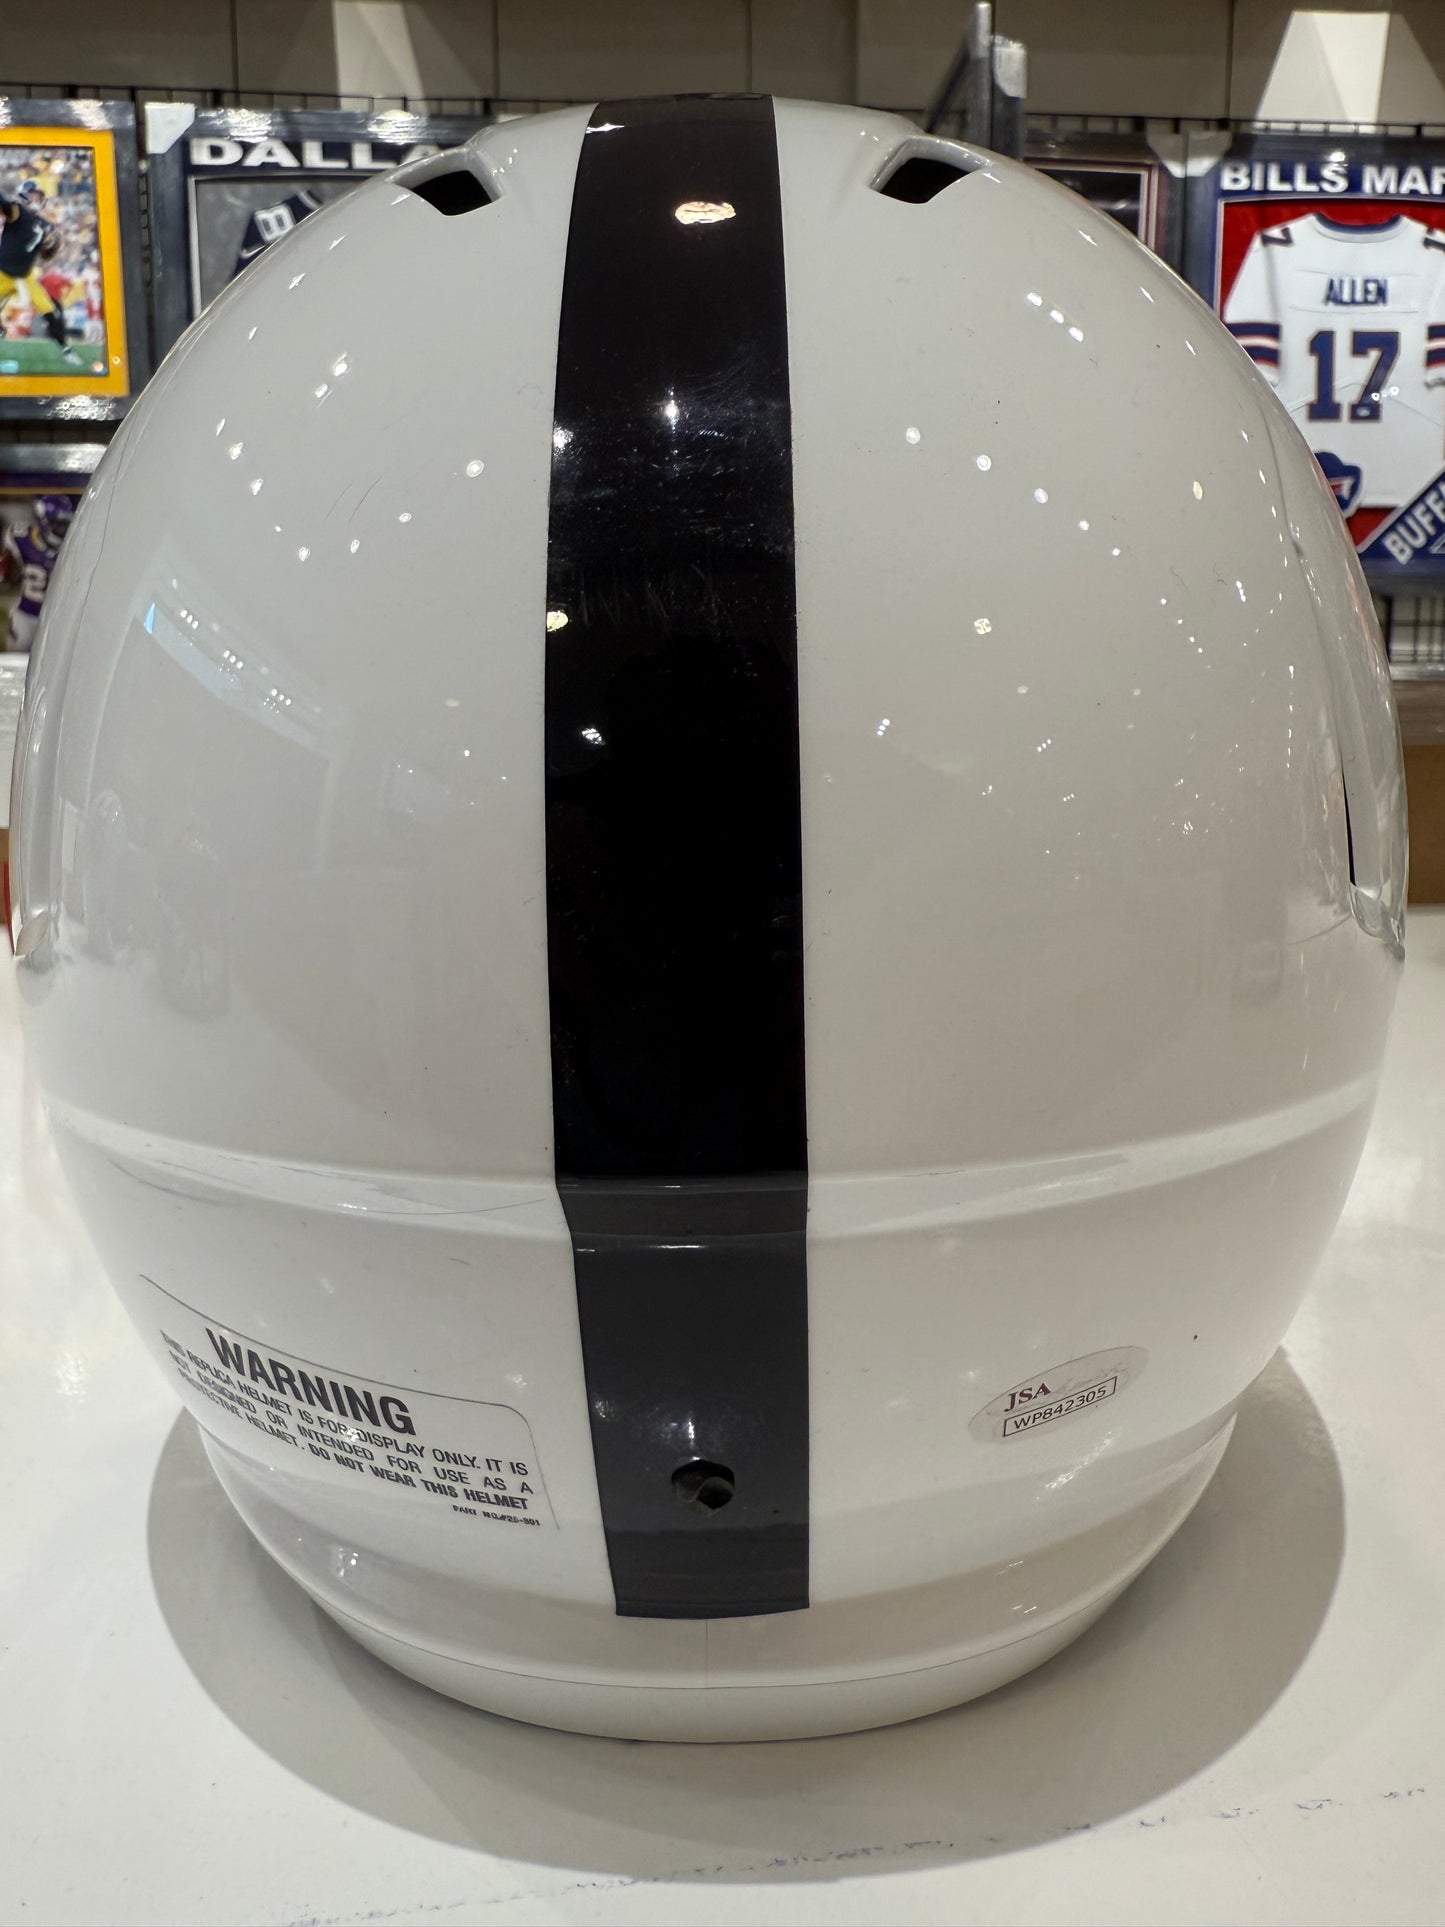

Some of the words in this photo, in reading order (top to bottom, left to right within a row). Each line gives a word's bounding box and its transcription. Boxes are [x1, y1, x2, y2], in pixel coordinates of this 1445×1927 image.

[1220, 162, 1349, 193] BILLS
[1324, 277, 1389, 306] ALLEN
[1307, 329, 1400, 422] 17
[1381, 480, 1445, 565] BUFF
[205, 1327, 416, 1436] WARNING
[1004, 1383, 1051, 1412] JSA
[1014, 1386, 1106, 1430] WP842305
[237, 1380, 292, 1416] HELMET
[298, 1408, 314, 1425] IS
[317, 1415, 348, 1436] FOR
[355, 1428, 425, 1458] DISPLAY
[432, 1448, 480, 1469] ONLY.
[485, 1458, 502, 1472] IT
[509, 1461, 528, 1476] IS
[266, 1410, 288, 1430] OR
[297, 1423, 375, 1461] INTENDED
[386, 1454, 422, 1475] FOR
[433, 1466, 471, 1485] USE
[483, 1476, 507, 1491] AS
[520, 1482, 534, 1494] A
[308, 1442, 331, 1461] DO
[333, 1452, 364, 1473] NOT
[369, 1464, 417, 1488] WEAR
[420, 1478, 459, 1498] THIS
[463, 1488, 528, 1510] HELMET
